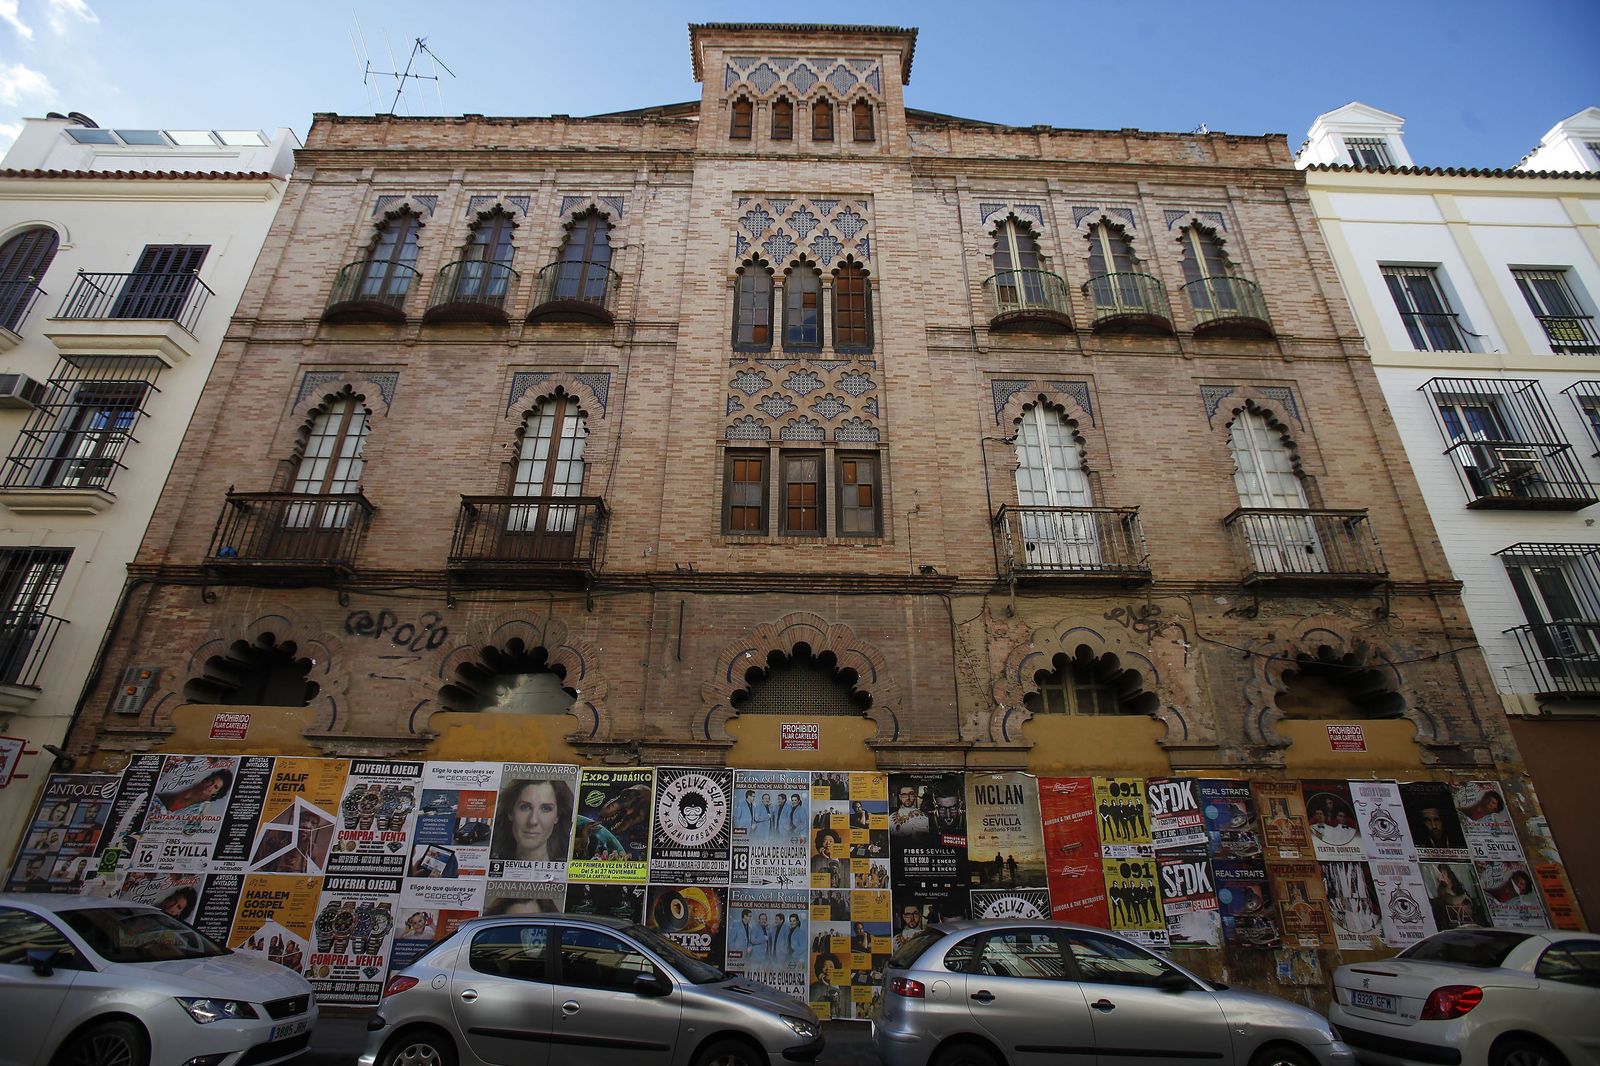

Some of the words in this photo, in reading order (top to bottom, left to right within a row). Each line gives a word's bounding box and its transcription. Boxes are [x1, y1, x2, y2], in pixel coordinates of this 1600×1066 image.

[216, 714, 250, 722] PROHIBIDO
[782, 724, 818, 732] PROHIBIDO
[1328, 726, 1361, 734] PROHIBIDO
[354, 764, 390, 774] JOYERIA
[392, 765, 418, 775] OJEDA
[504, 765, 532, 773] DIANA
[533, 766, 577, 774] NAVARRO
[276, 773, 309, 782] SALIF
[582, 773, 610, 782] EXPO
[612, 772, 652, 782] JURÁSICO
[736, 774, 758, 783] Ecos
[762, 774, 776, 782] del
[48, 784, 101, 797] ANTIQUE
[273, 783, 306, 792] KEITA
[663, 792, 677, 808] LA
[676, 778, 707, 792] SELVA
[708, 786, 724, 807] SUR
[1110, 782, 1142, 797] 091
[974, 784, 1024, 805] MCLAN
[1148, 780, 1198, 814] SFDK
[982, 818, 1021, 826] SEVILLA
[1178, 815, 1200, 826] SEVILLA
[338, 831, 374, 840] COMPRA
[381, 832, 406, 841] VENTA
[163, 846, 208, 857] SEVILLA
[1137, 846, 1154, 854] 091
[1474, 847, 1484, 855] 16
[1488, 843, 1516, 851] SEVILLA
[139, 851, 153, 863] 16
[733, 853, 747, 869] 18
[493, 863, 500, 872] 9
[1120, 862, 1154, 878] 091
[327, 878, 366, 890] JOYERIA
[368, 880, 397, 891] OJEDA
[1162, 862, 1213, 898] SFDK
[487, 881, 516, 890] DIANA
[519, 883, 565, 892] NAVARRO
[246, 891, 290, 900] HARLEM
[732, 890, 756, 900] Ecos
[758, 891, 773, 900] del
[992, 897, 1025, 917] SELVA
[1193, 899, 1216, 911] SEVILLA
[241, 910, 274, 918] CHOIR
[1150, 931, 1166, 940] 091
[310, 954, 348, 965] COMPRA
[356, 955, 383, 966] VENTA
[1357, 992, 1373, 1006] 9328
[1376, 996, 1392, 1008] GFW
